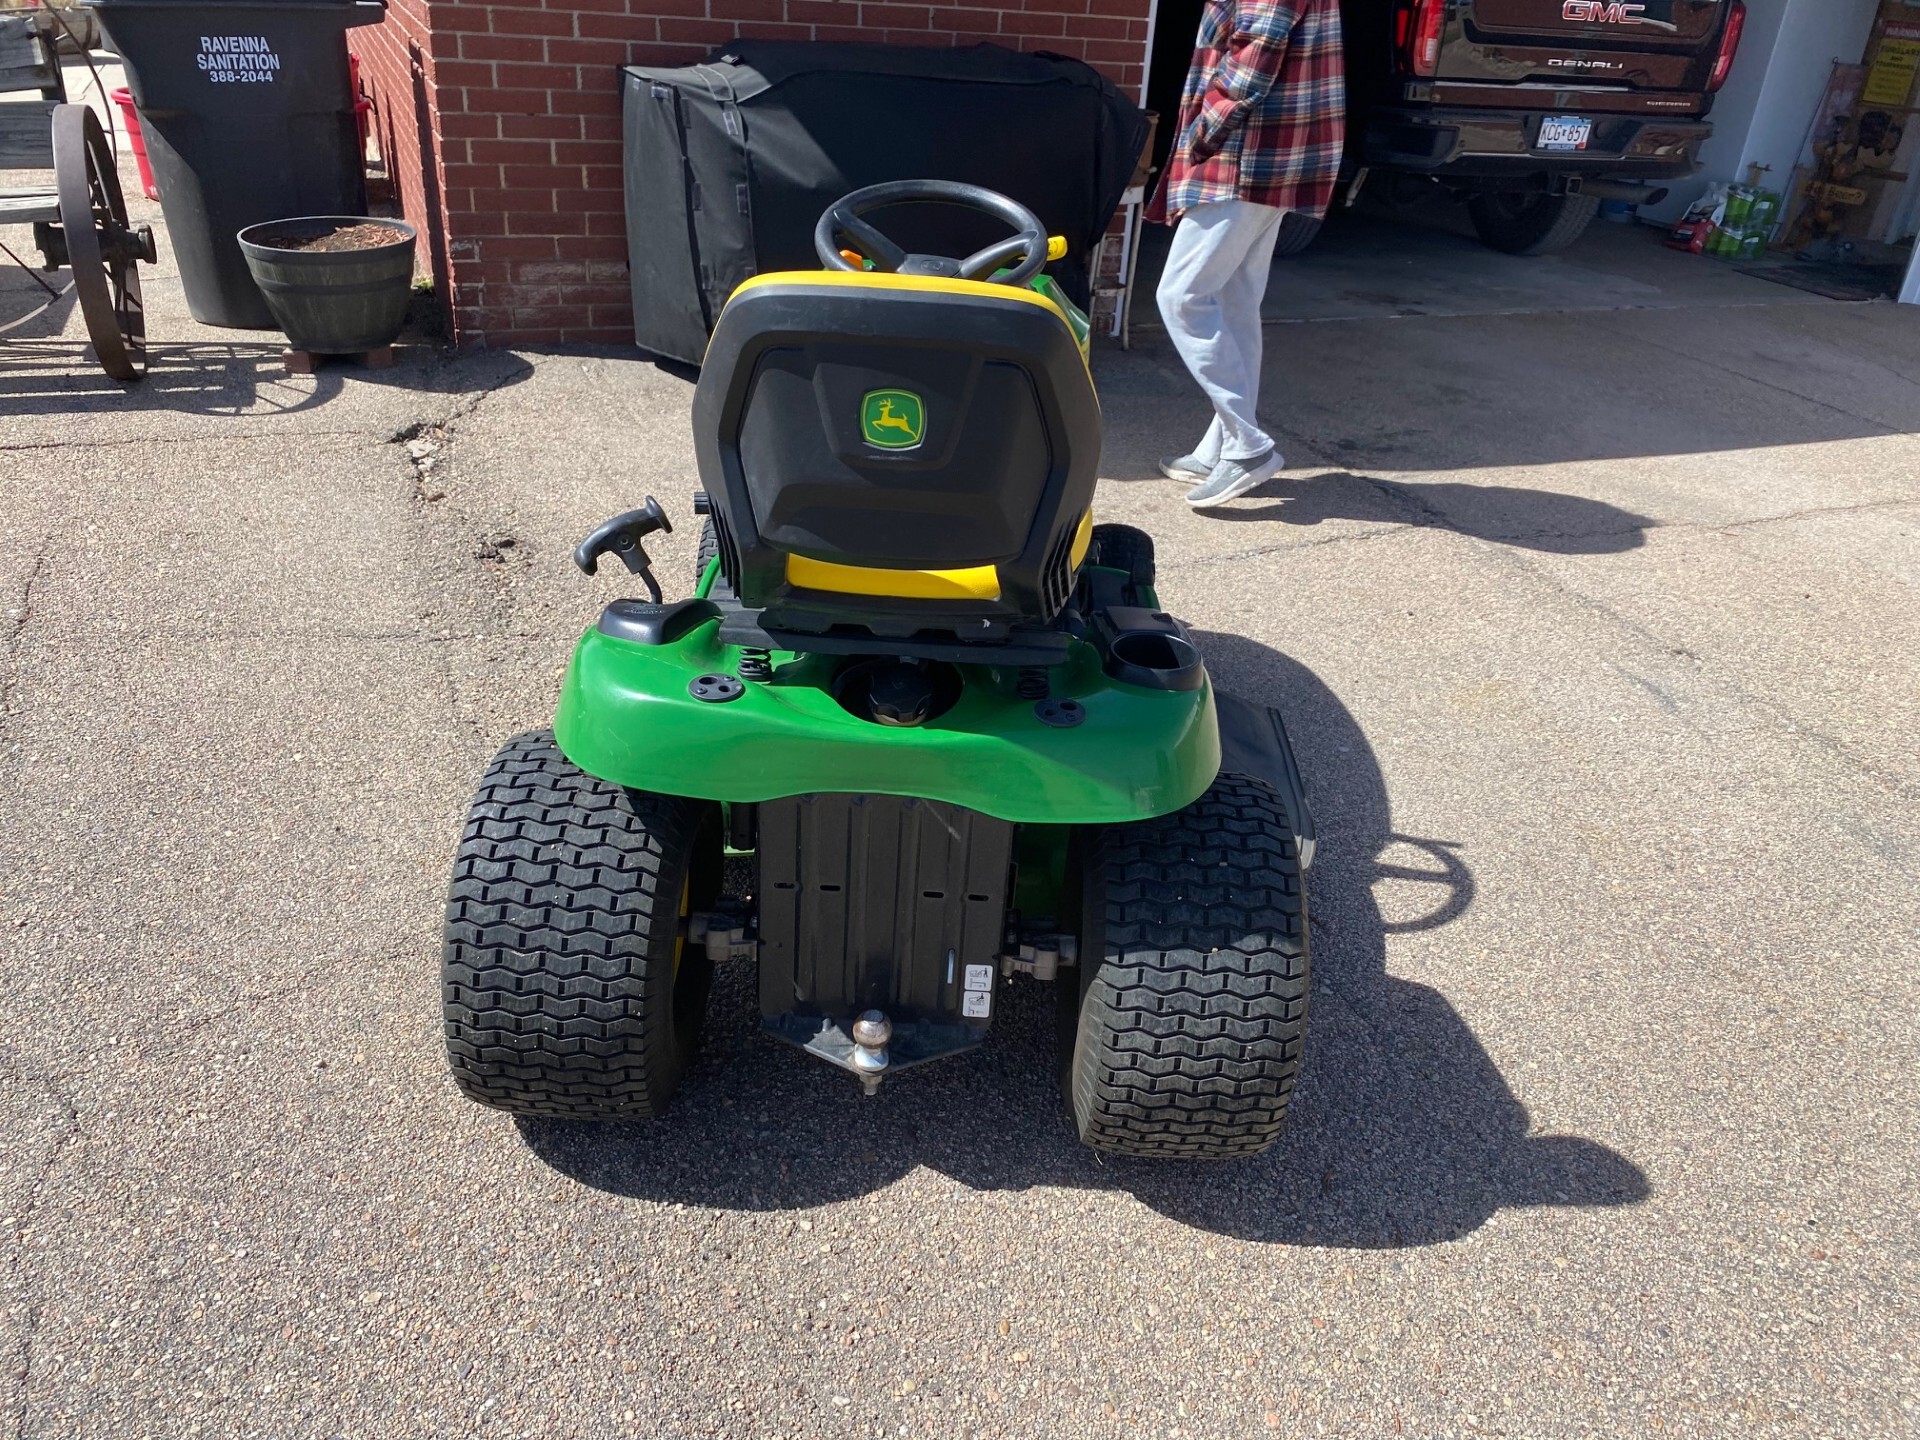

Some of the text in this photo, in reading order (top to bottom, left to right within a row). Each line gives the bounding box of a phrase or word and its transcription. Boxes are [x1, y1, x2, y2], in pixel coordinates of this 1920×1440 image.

[1562, 0, 1645, 24] GMC
[1885, 26, 1920, 39] WARNIN
[200, 36, 271, 53] RAVENNA
[196, 53, 281, 70] SANITATION
[1547, 58, 1624, 70] DENALI
[209, 70, 274, 83] 388-2044
[1567, 124, 1589, 142] 857
